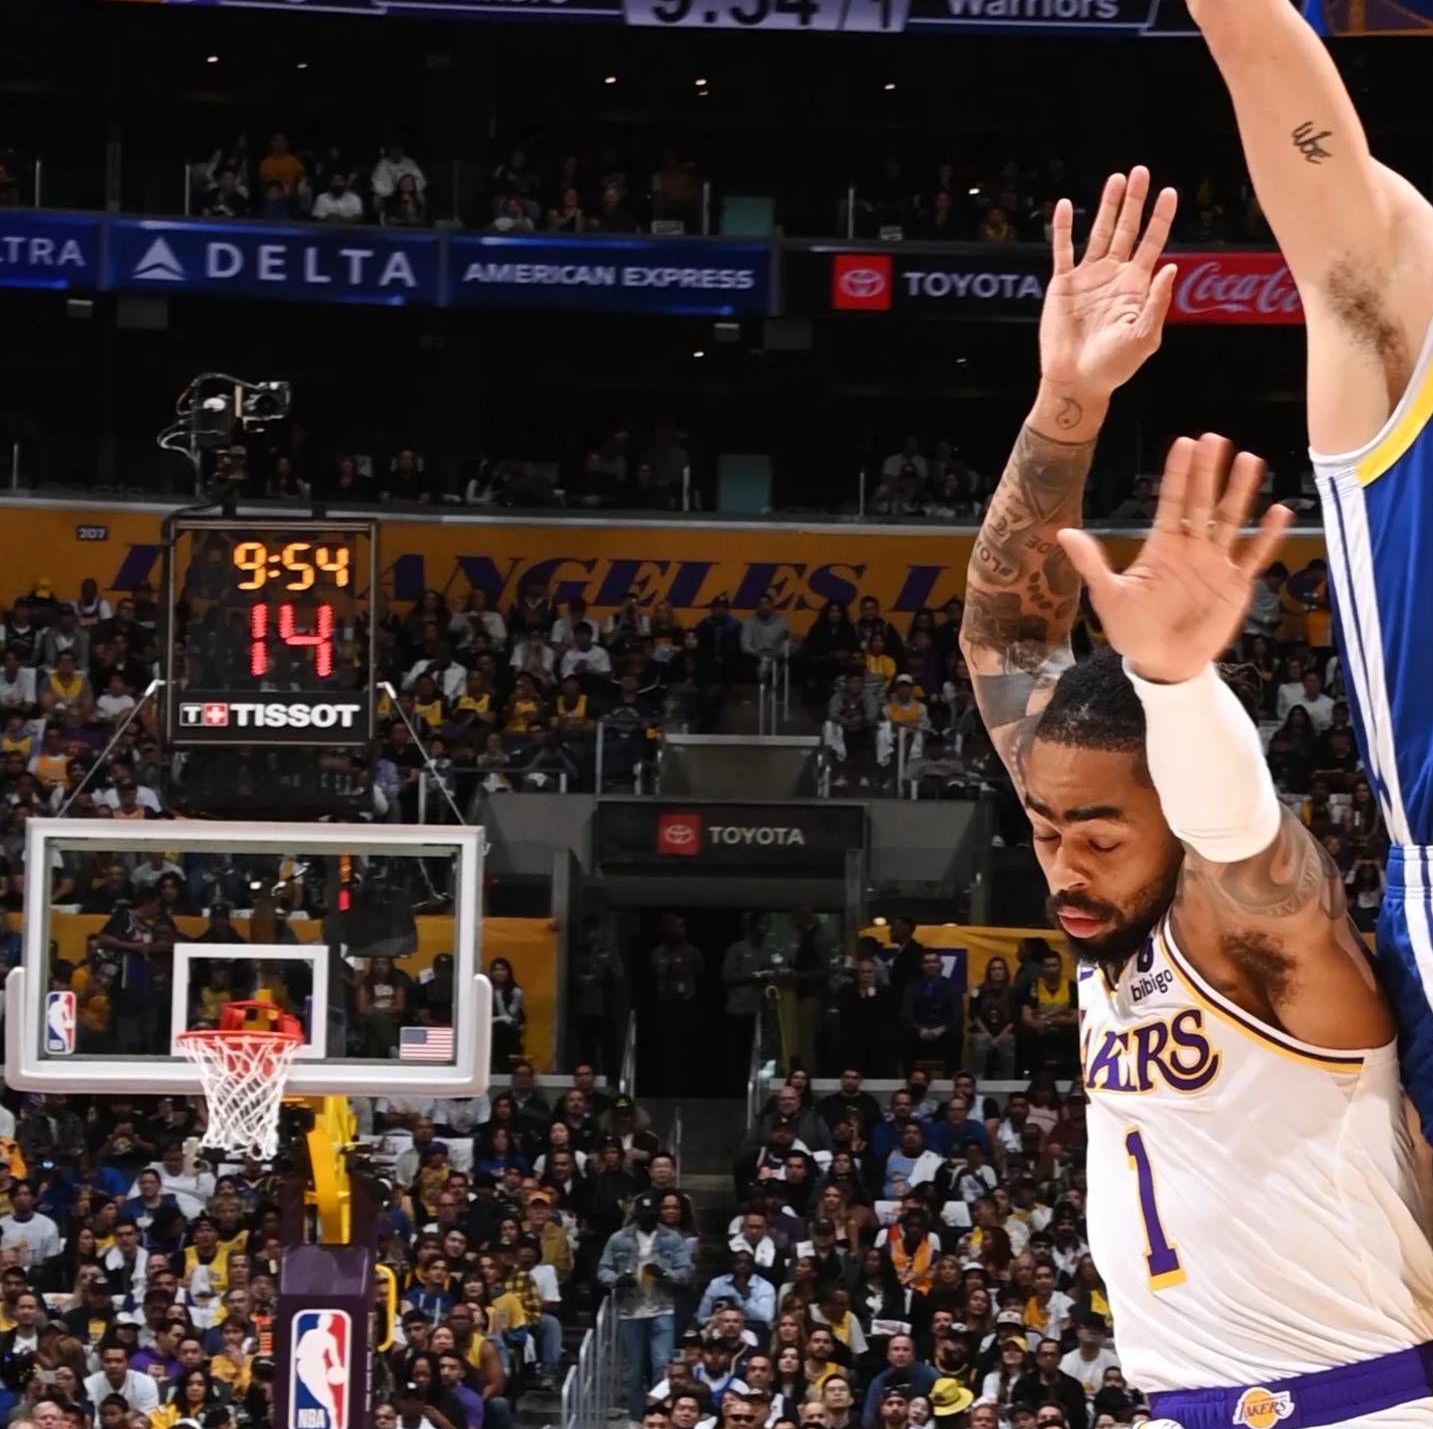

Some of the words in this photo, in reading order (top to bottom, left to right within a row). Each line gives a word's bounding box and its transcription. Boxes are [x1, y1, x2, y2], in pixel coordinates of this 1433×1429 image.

[0, 236, 86, 267] TRA
[206, 242, 418, 288] DELTA
[463, 262, 615, 287] AMERICAN
[621, 266, 755, 291] EXPRESS
[903, 271, 1044, 299] TOYOTA
[232, 540, 350, 591] 9:54
[249, 600, 335, 678] 14
[229, 703, 362, 728] TISSOT
[708, 825, 805, 846] TOYOTA
[1130, 968, 1174, 1003] bibigo
[1123, 1125, 1187, 1291] 1
[298, 1408, 327, 1429] NBA
